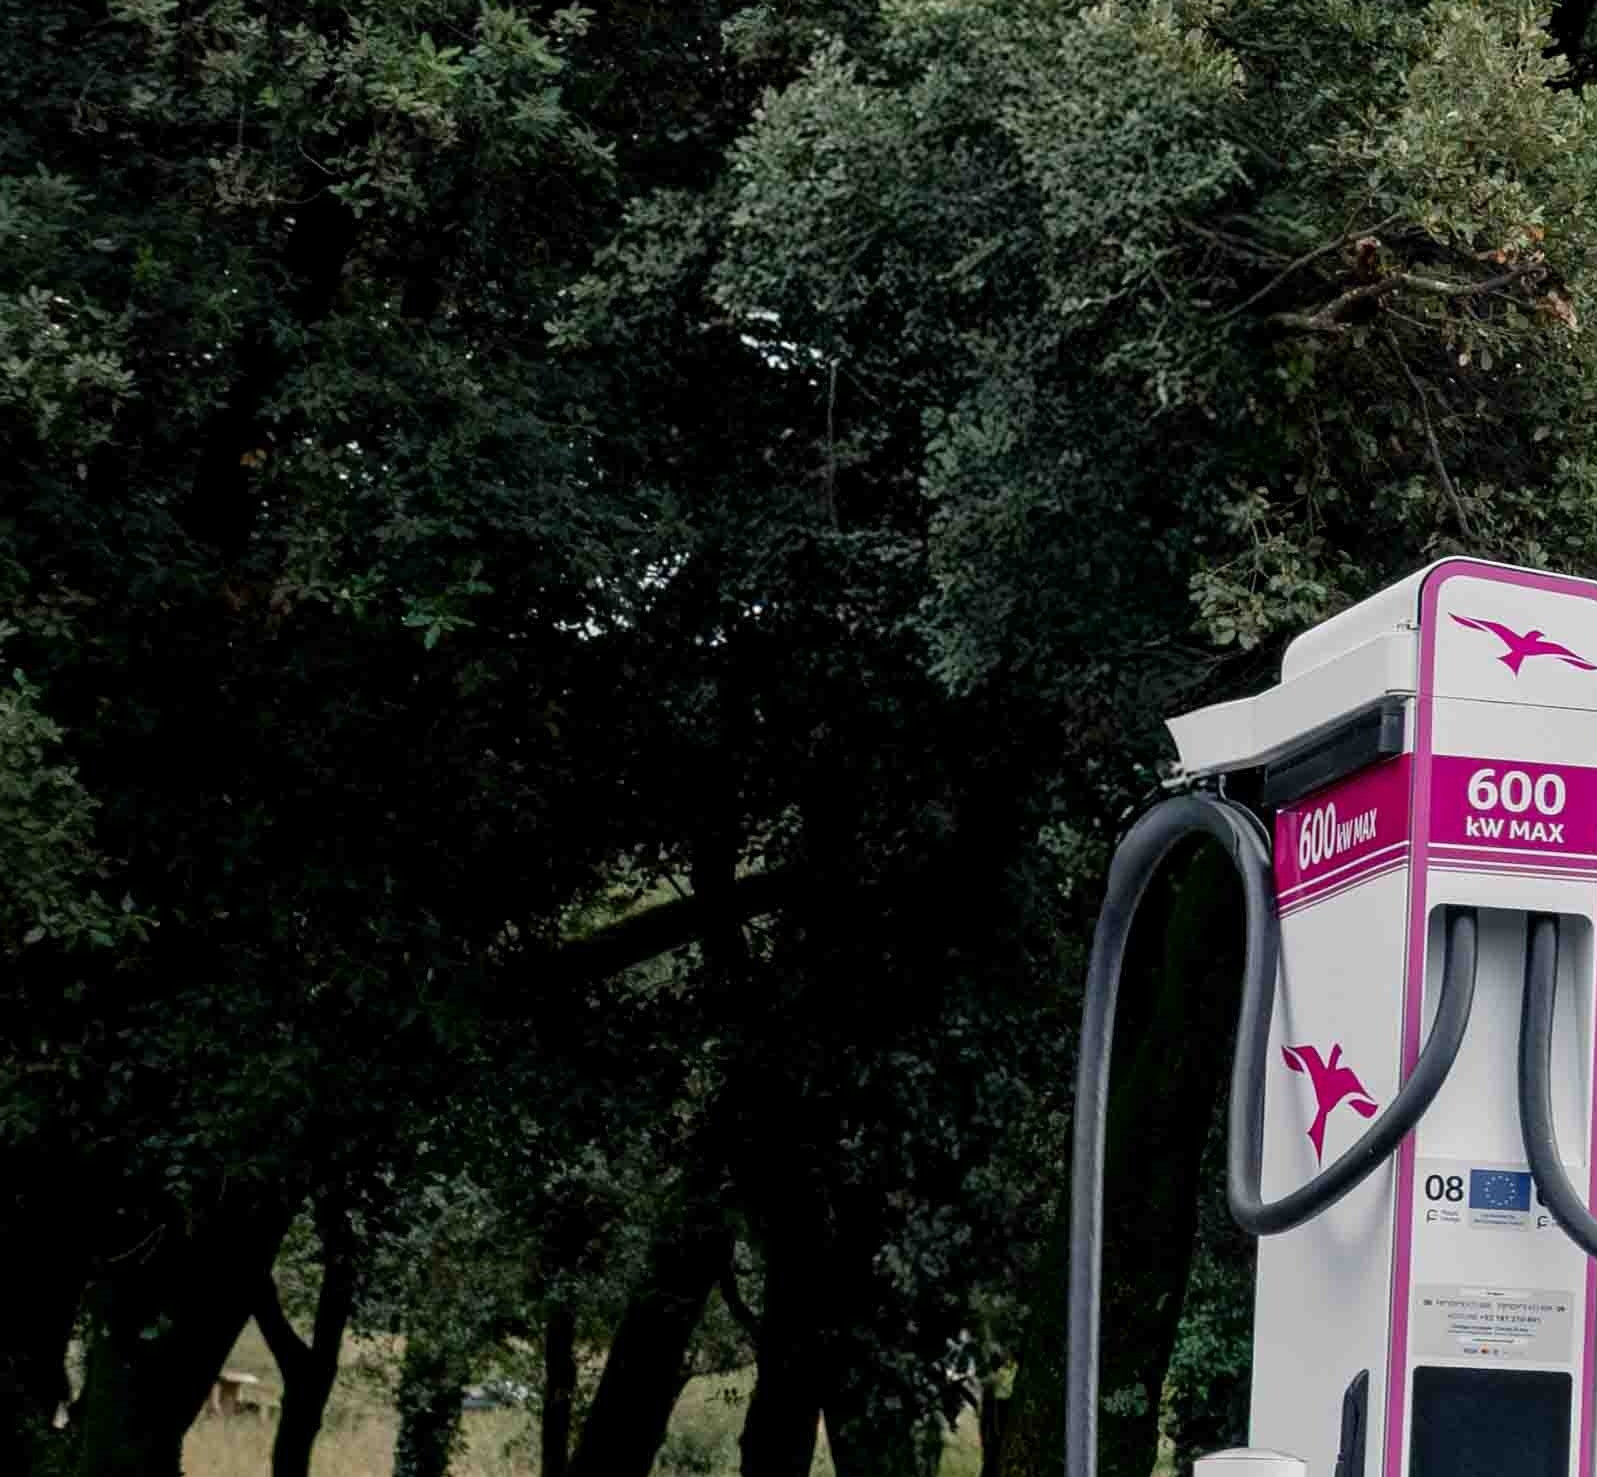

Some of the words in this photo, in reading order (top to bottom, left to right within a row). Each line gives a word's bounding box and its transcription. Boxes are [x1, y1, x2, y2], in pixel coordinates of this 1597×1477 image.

[1467, 768, 1566, 815] 600
[1298, 802, 1336, 871] 600
[1336, 819, 1354, 854] kW
[1353, 808, 1378, 846] MAX
[1465, 816, 1504, 838] kW
[1509, 820, 1564, 843] MAX
[1425, 1174, 1464, 1202] 08
